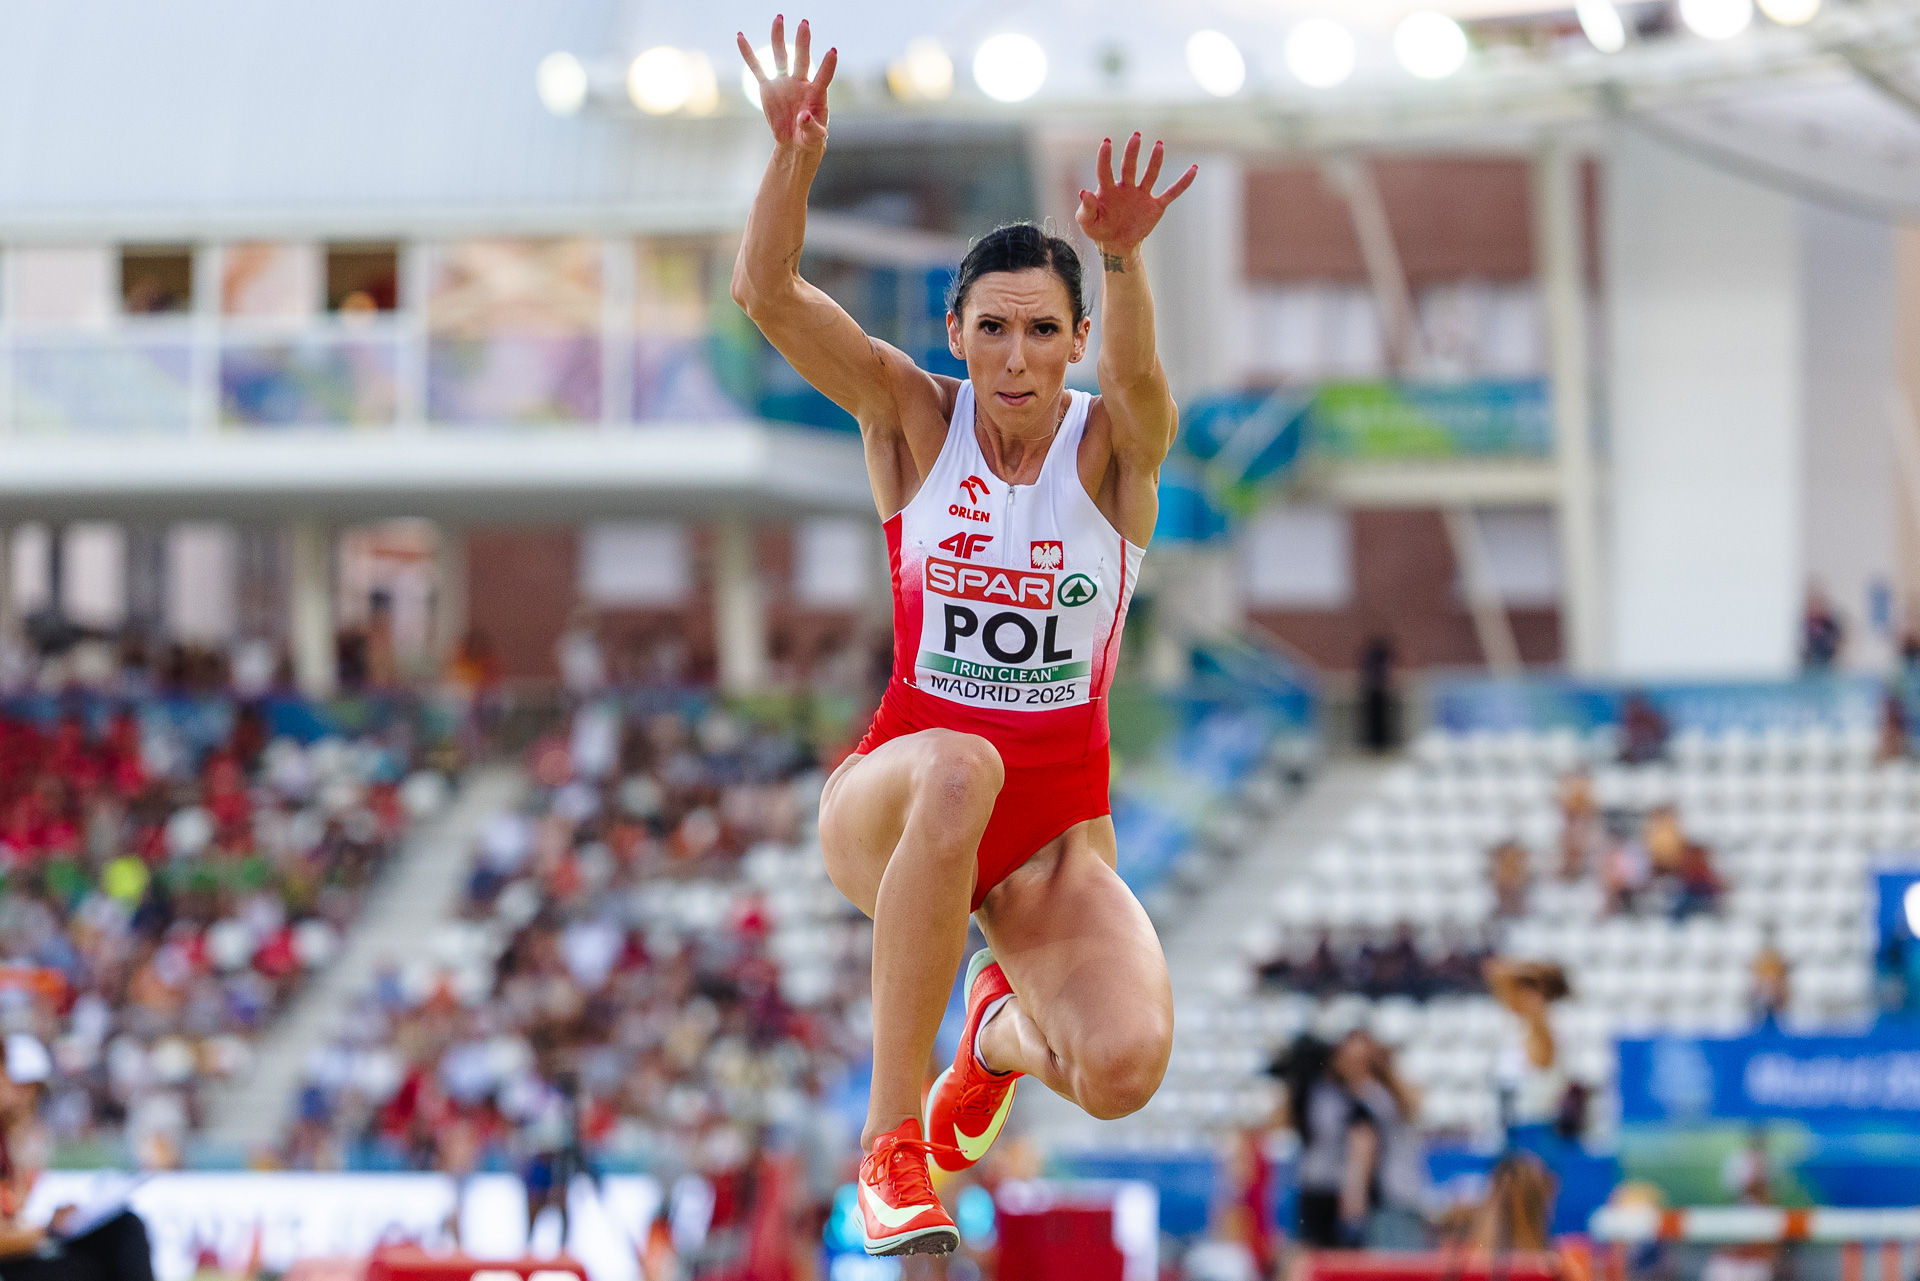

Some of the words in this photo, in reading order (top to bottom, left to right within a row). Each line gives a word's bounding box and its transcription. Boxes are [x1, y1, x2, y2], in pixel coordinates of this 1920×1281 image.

[949, 504, 990, 522] ORLEN
[939, 532, 993, 559] 4F
[929, 563, 1050, 605] SPAR
[944, 603, 1072, 664] POL
[951, 660, 958, 672] I
[960, 662, 994, 679] RUN
[931, 676, 1020, 702] MADRID
[1026, 684, 1075, 703] 2025
